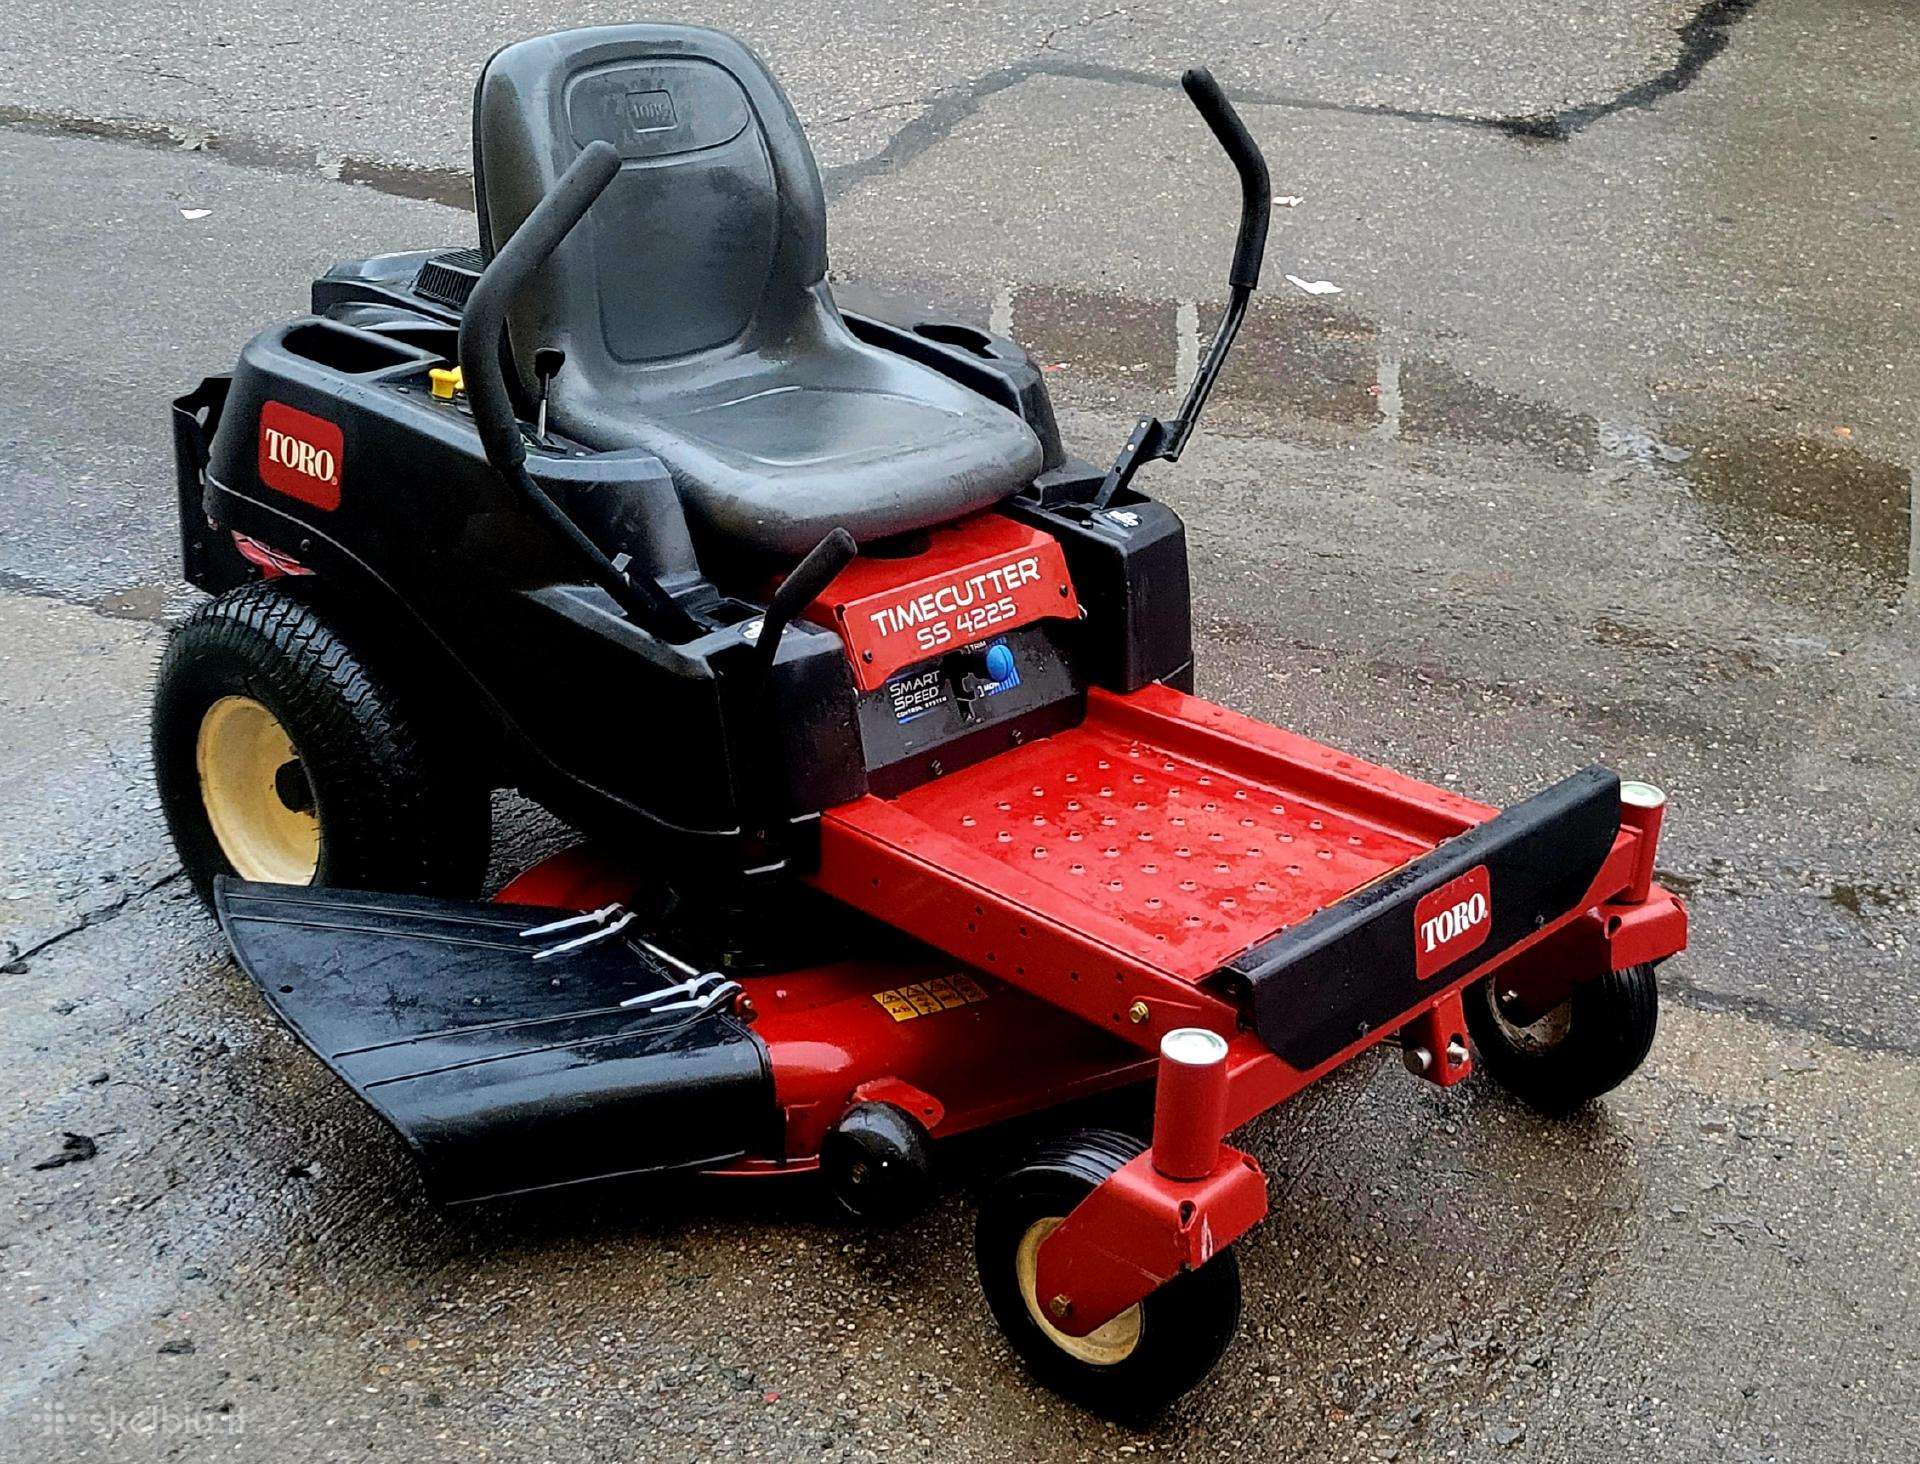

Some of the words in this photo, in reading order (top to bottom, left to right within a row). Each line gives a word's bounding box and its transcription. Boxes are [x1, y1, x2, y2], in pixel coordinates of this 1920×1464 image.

[265, 428, 335, 482] TORO
[870, 557, 1041, 637] TIMECUTTER
[916, 621, 951, 650] SS
[956, 597, 1017, 633] 4225
[889, 670, 940, 698] SMART
[894, 686, 939, 712] SPEED
[1421, 893, 1486, 953] TORO
